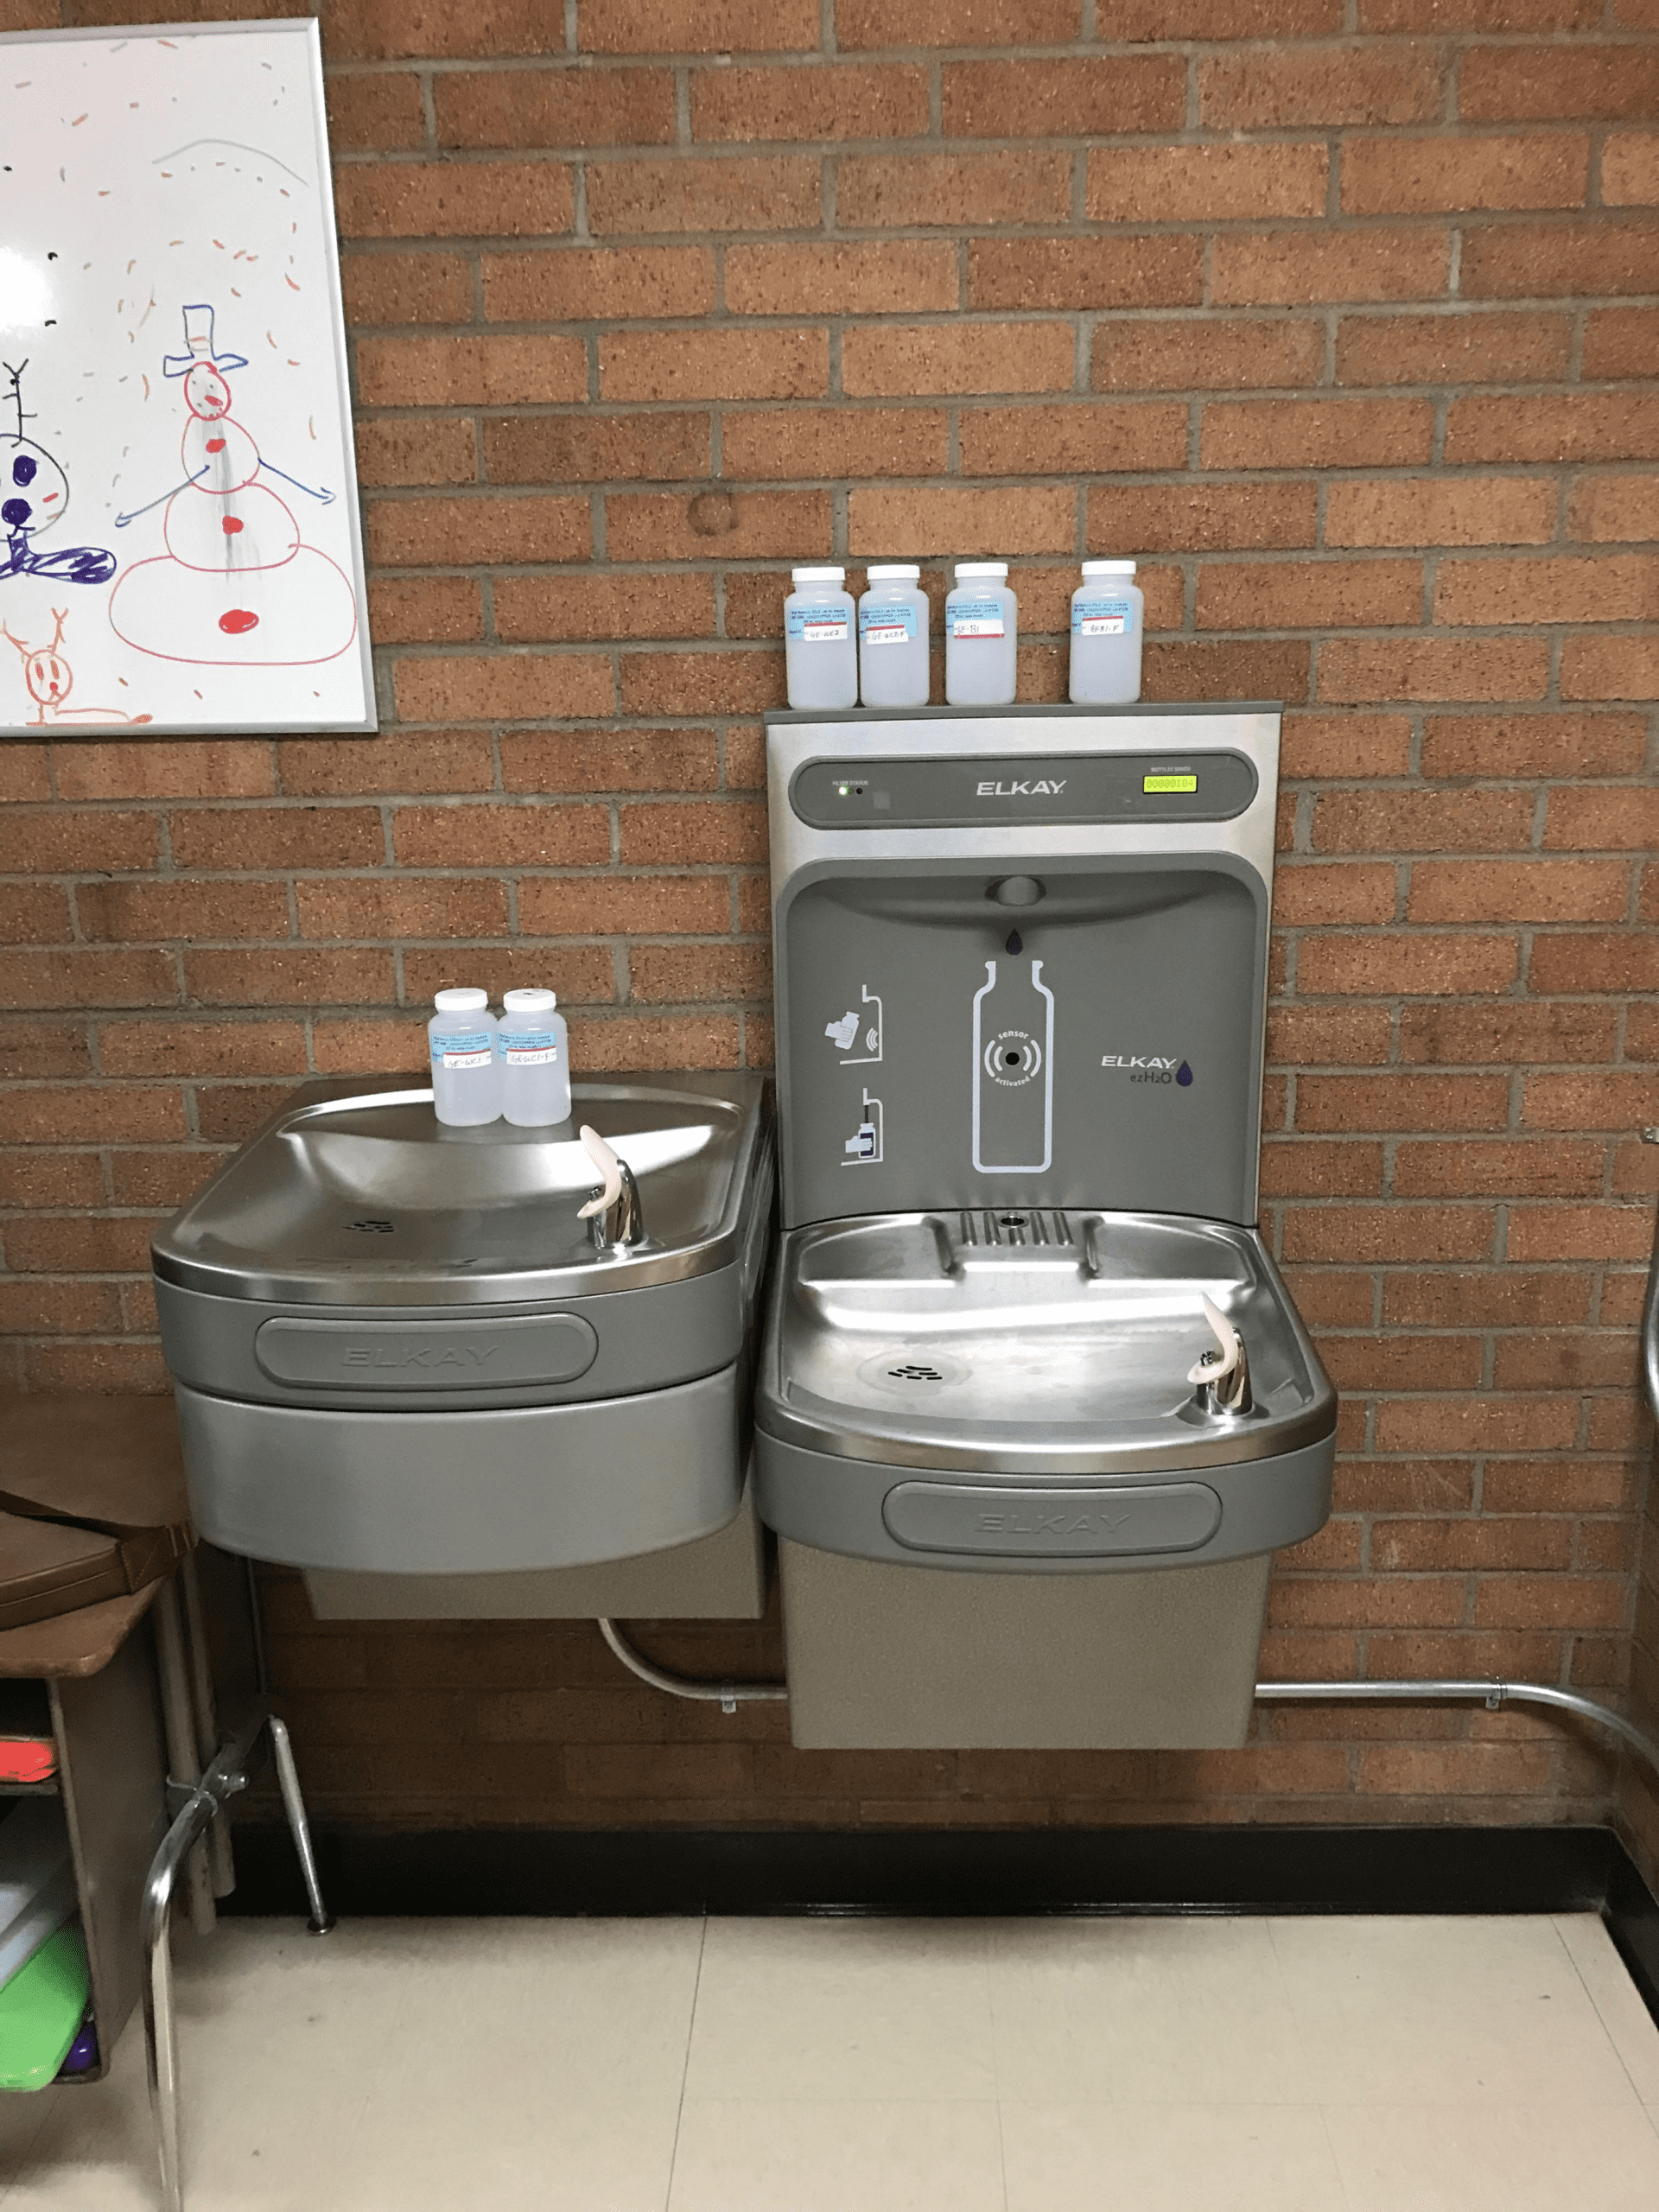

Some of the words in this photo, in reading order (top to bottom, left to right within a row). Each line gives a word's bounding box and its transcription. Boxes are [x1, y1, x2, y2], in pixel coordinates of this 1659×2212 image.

[976, 779, 1068, 796] ELKAY
[997, 1030, 1030, 1040] sensor
[1101, 1055, 1177, 1069] ELKAY
[995, 1075, 1031, 1087] activated
[341, 1344, 499, 1367] ELKAY
[974, 1512, 1132, 1535] ELKAY
